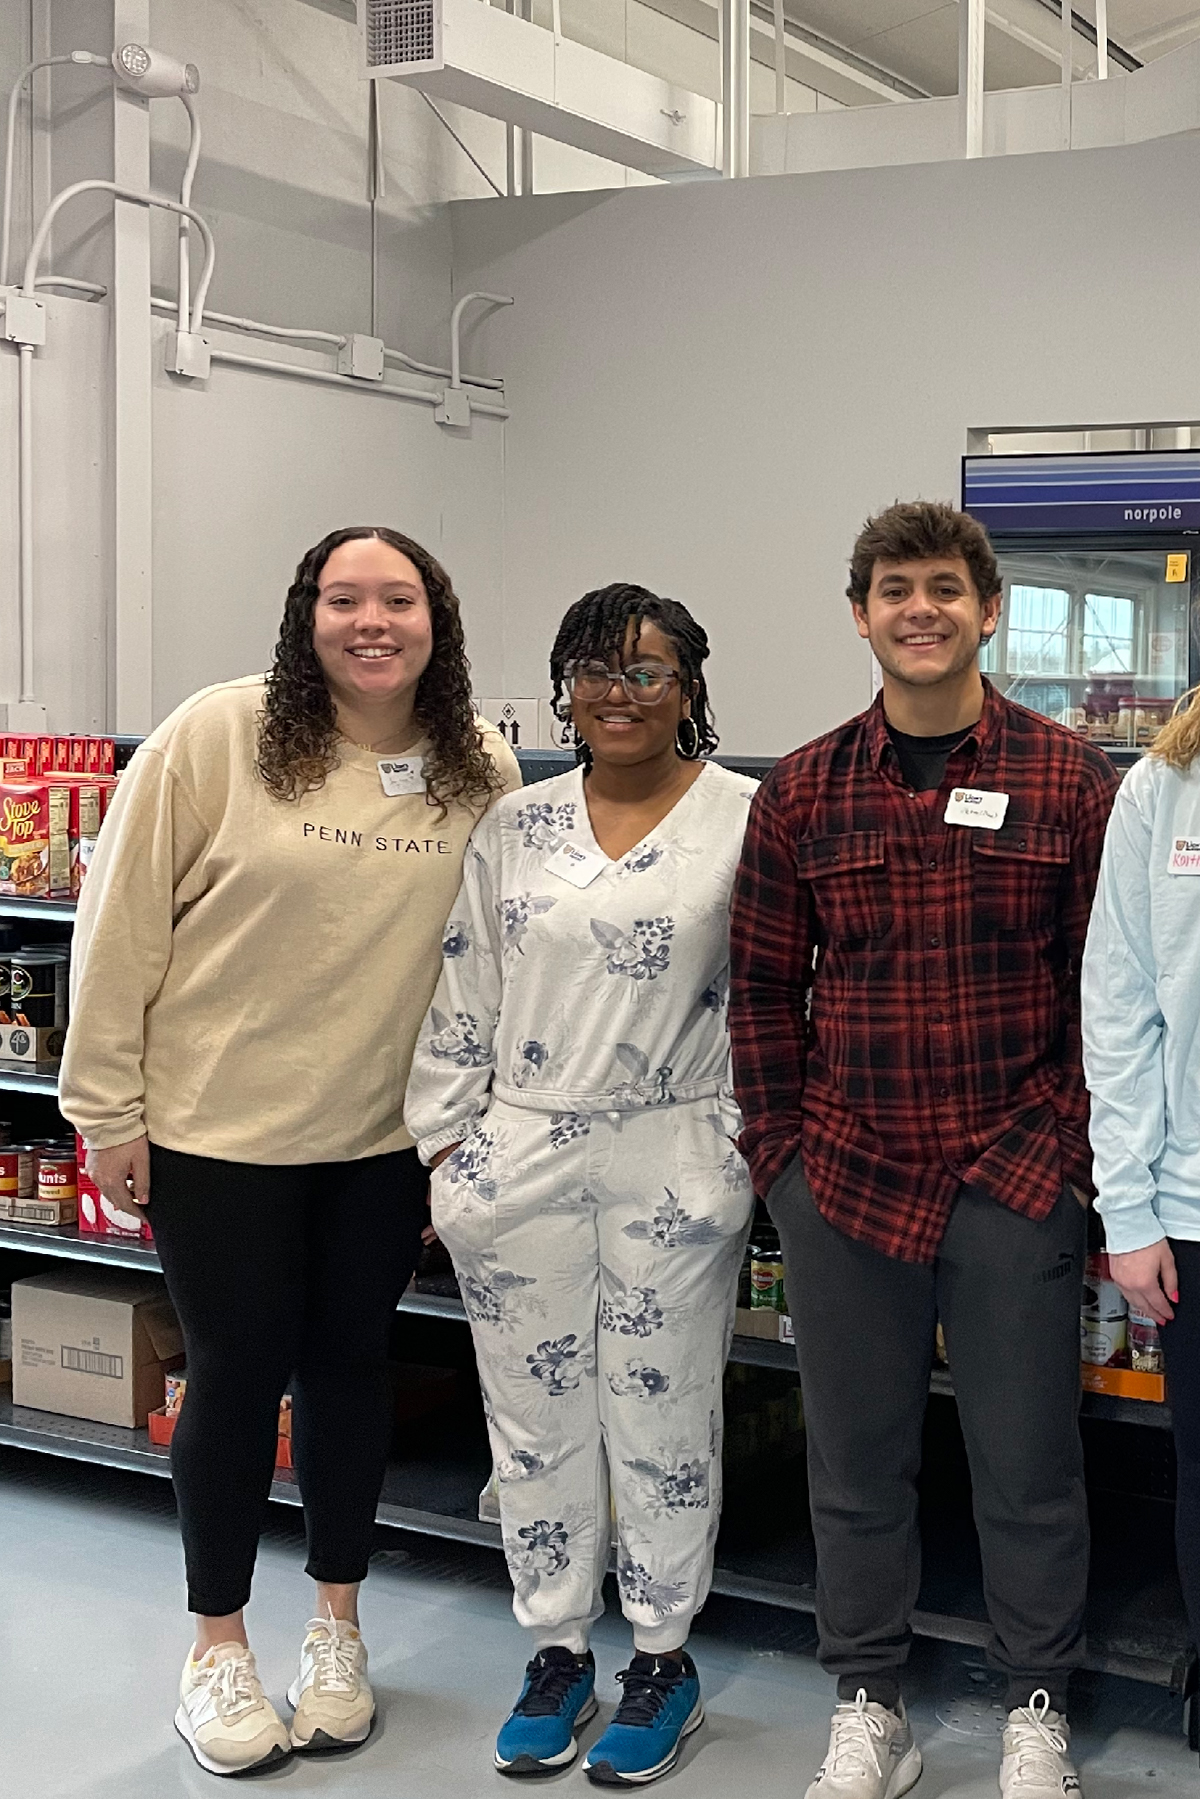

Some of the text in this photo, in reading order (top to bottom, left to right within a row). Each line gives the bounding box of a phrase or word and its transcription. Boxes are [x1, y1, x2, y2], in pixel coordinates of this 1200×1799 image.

[1124, 504, 1182, 523] norpole
[0, 796, 41, 832] Stove
[12, 820, 35, 841] Top
[303, 822, 453, 855] PENN STATE
